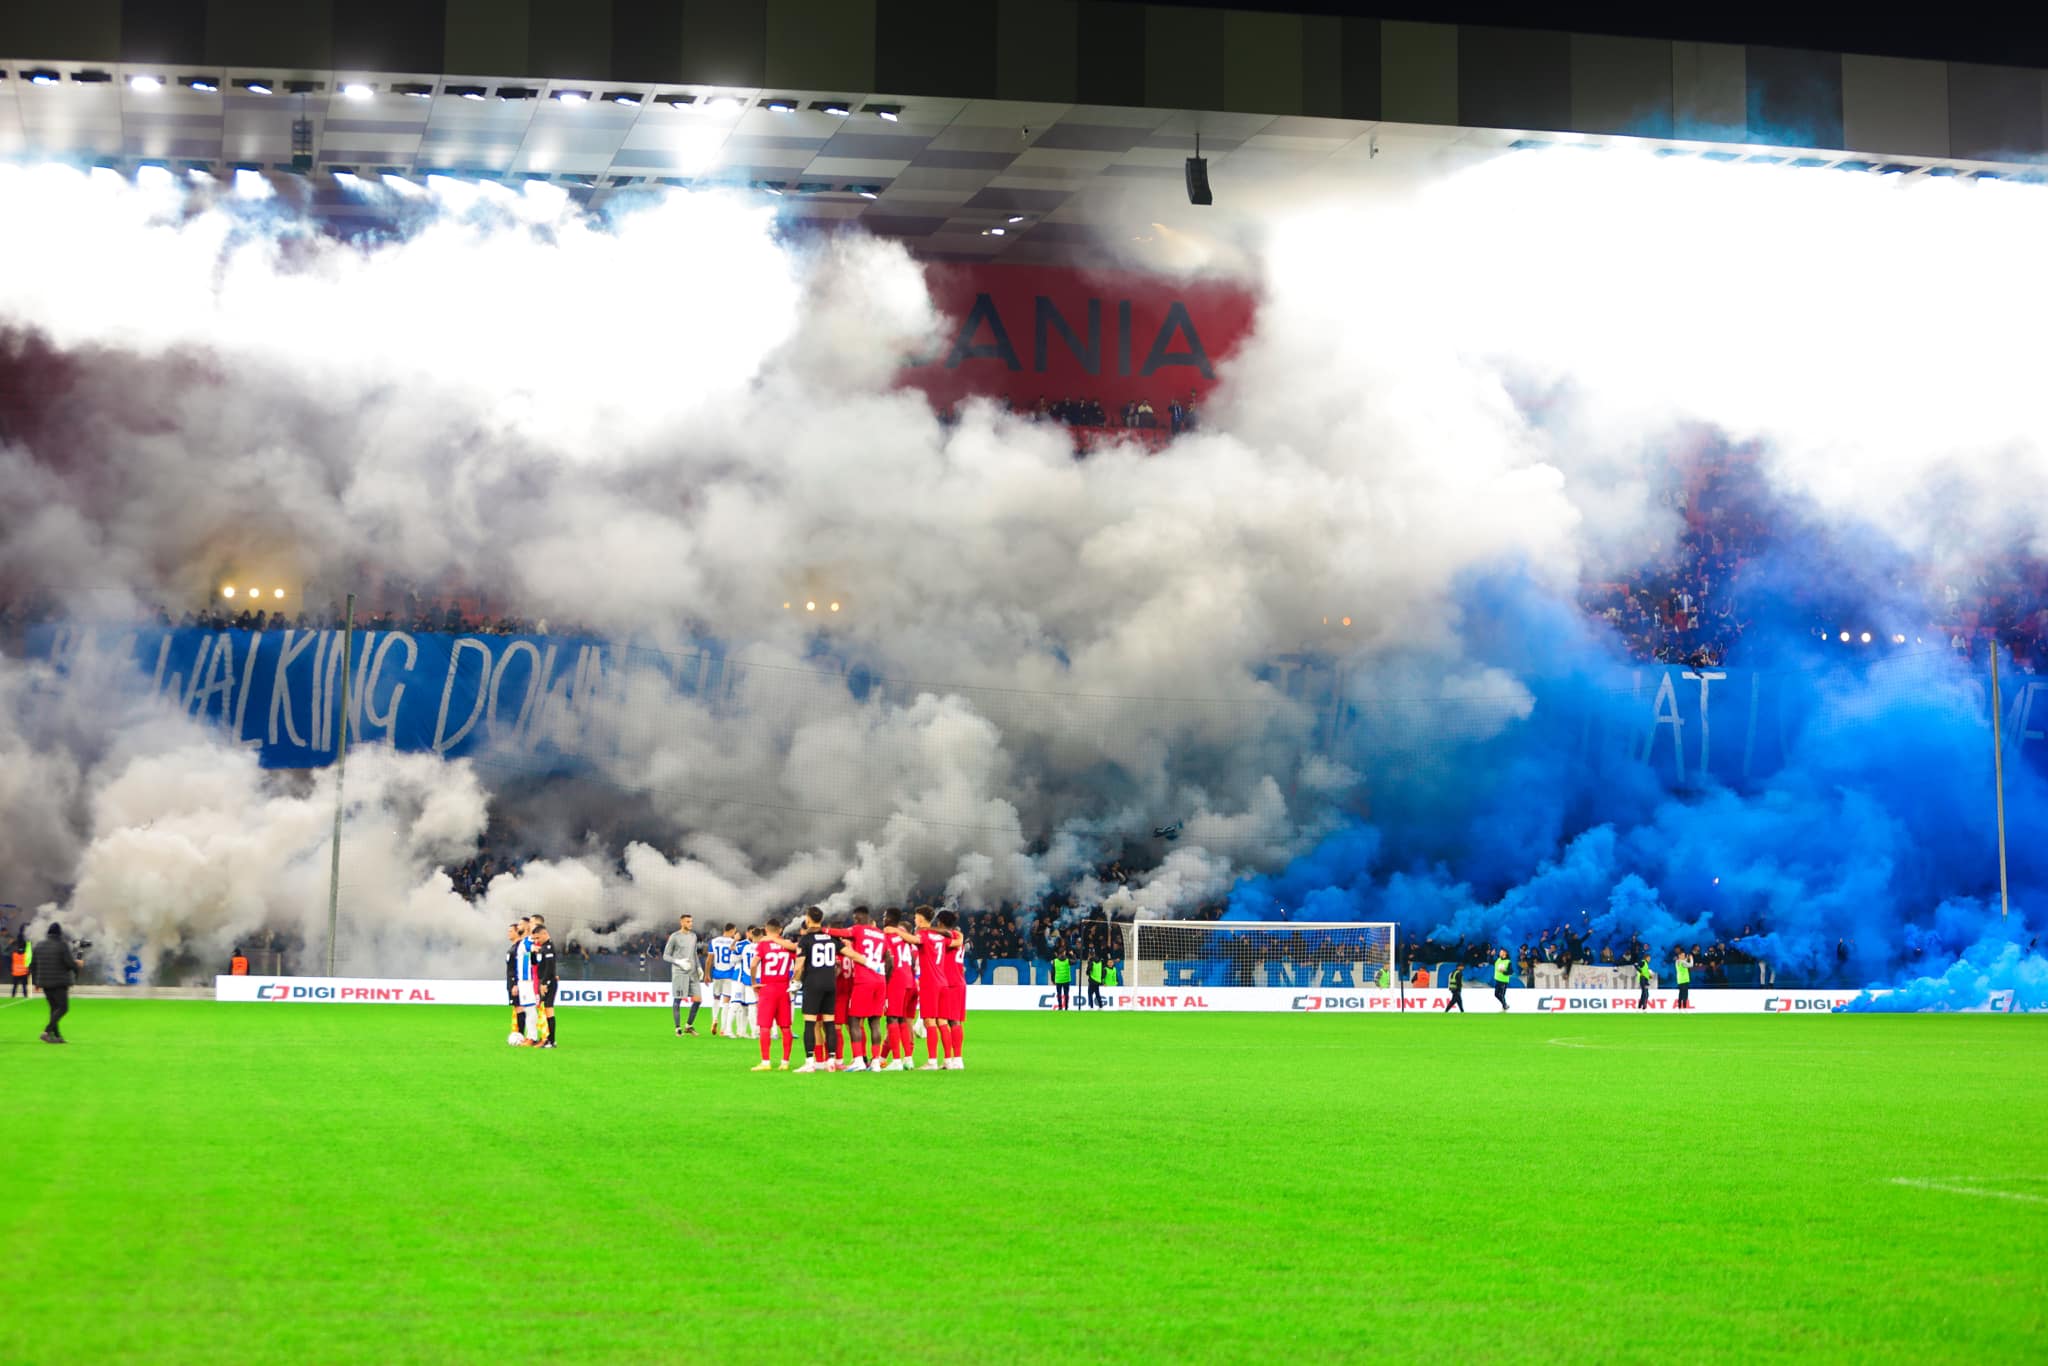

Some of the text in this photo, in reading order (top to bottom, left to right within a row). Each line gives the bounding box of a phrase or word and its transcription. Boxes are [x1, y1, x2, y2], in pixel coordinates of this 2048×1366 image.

[715, 946, 732, 964] 18
[811, 942, 836, 967] 60
[862, 938, 884, 963] 34
[897, 943, 912, 968] 14
[934, 942, 944, 965] 7
[764, 952, 790, 976] 27
[293, 986, 435, 1001] DIGI PRINT AL
[560, 990, 603, 1002] DIGI
[607, 991, 669, 1003] PRINT
[1072, 995, 1114, 1007] DGI
[1183, 996, 1208, 1008] AL
[1325, 997, 1364, 1009] DIGI
[1569, 998, 1608, 1009] DIGI
[1611, 998, 1668, 1010] PRNT
[1794, 999, 1832, 1010] DIGI
